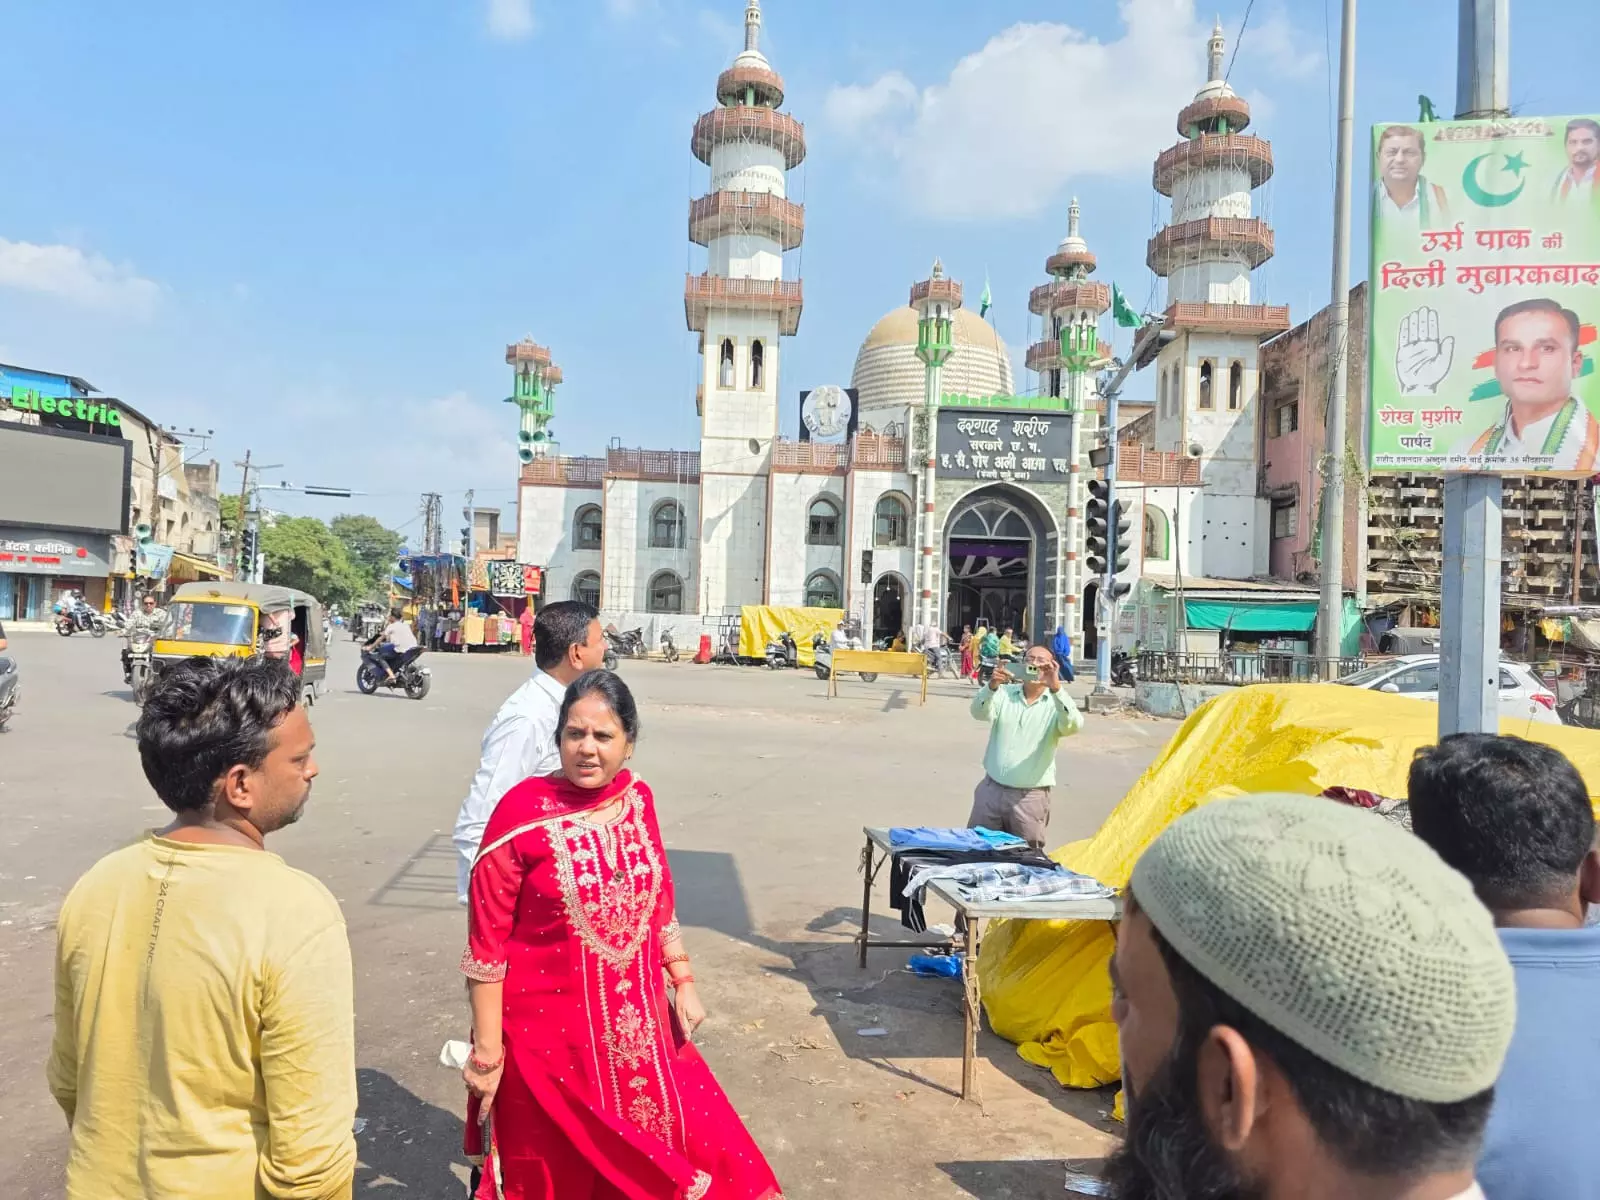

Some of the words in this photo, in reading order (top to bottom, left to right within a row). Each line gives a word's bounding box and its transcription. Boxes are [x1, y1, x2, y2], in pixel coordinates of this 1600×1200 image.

[1421, 222, 1464, 252] उर्स
[1475, 229, 1532, 251] पाक
[1542, 232, 1563, 250] की
[1381, 259, 1446, 290] दिली
[1456, 264, 1600, 295] मुबारकबाद
[12, 385, 121, 426] Electric
[957, 418, 1000, 436] दरगाह
[1012, 416, 1051, 438] शरीफ
[1380, 406, 1414, 425] शेख
[1421, 406, 1464, 428] मुशीर
[968, 437, 1003, 451] सरकारे
[1400, 433, 1432, 450] पार्षद
[994, 451, 1017, 470] अली
[158, 882, 169, 897] 24
[151, 899, 164, 940] CRAFT
